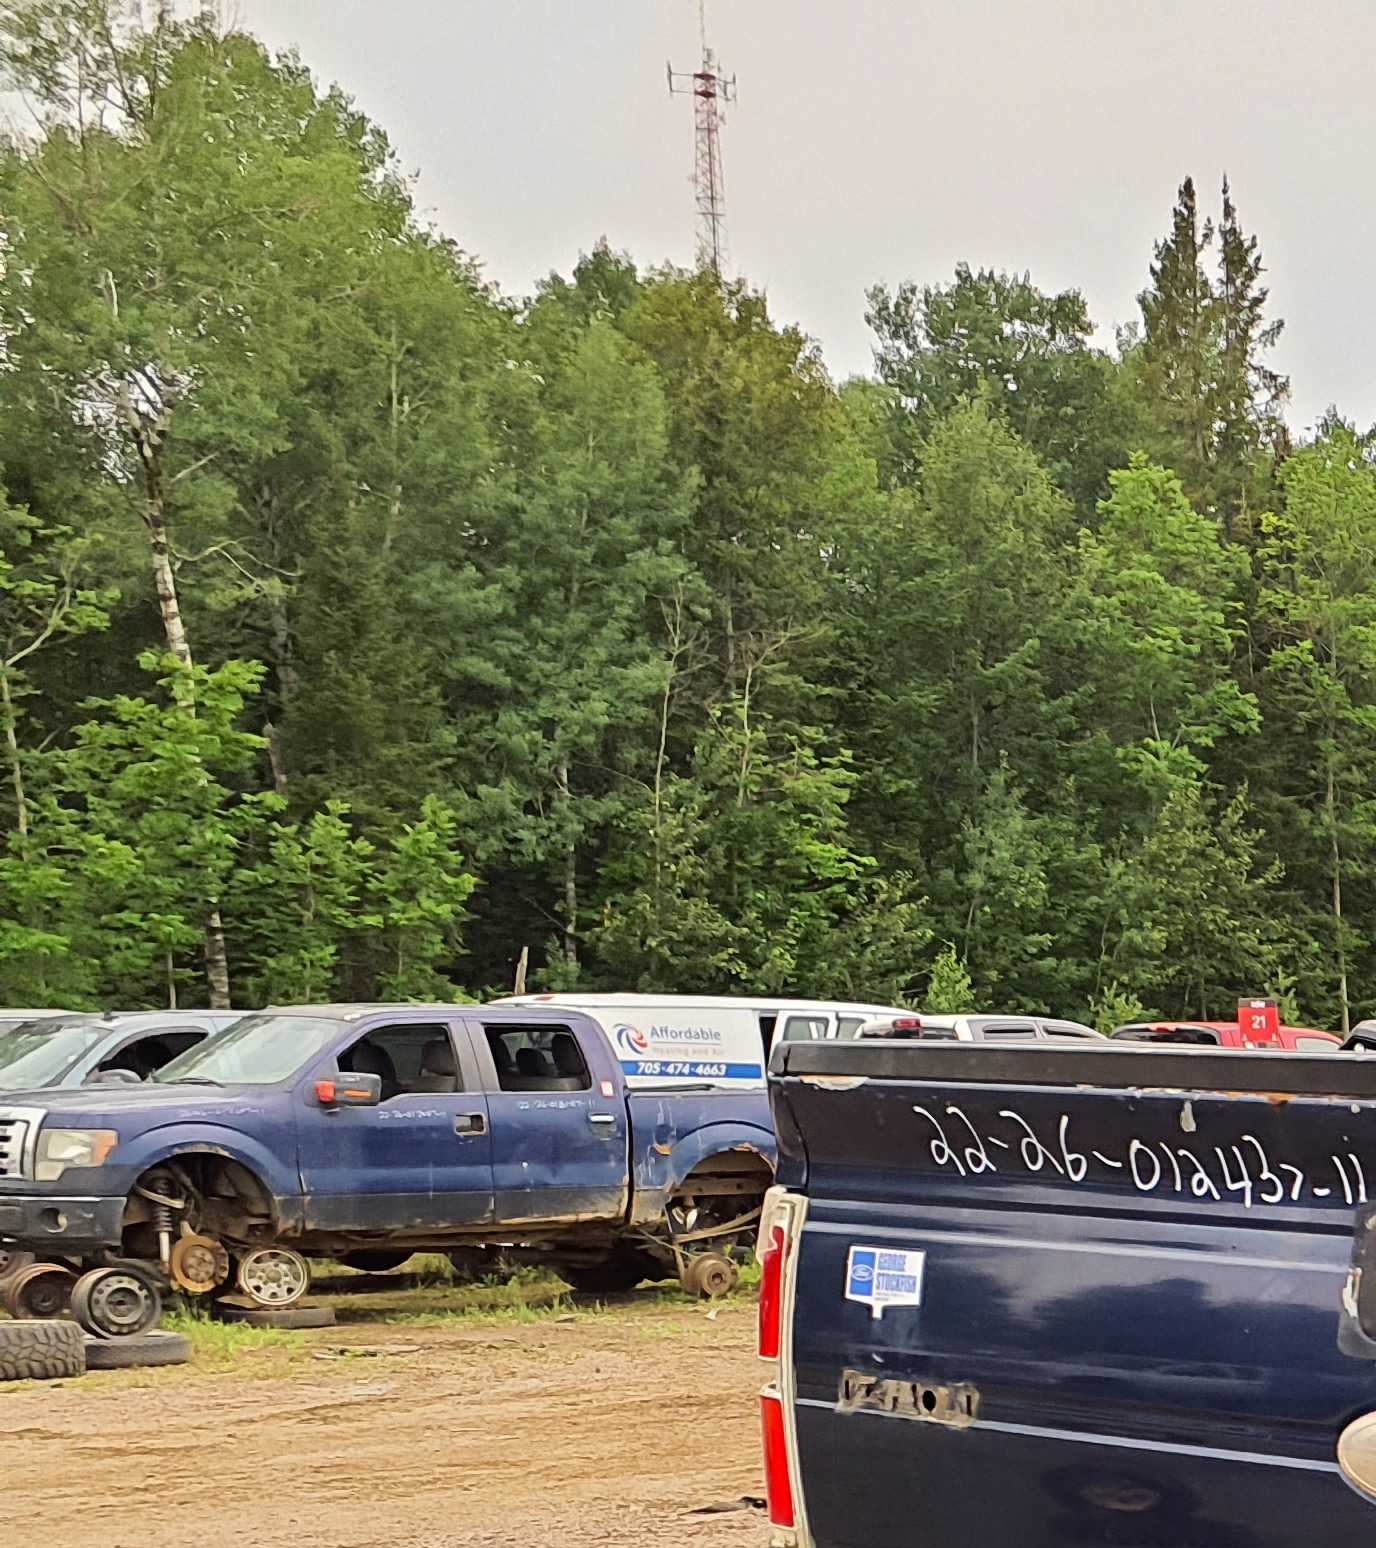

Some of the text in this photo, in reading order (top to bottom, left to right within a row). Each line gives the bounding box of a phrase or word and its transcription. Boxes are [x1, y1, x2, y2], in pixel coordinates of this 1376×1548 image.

[1251, 1015, 1266, 1029] 21
[650, 1025, 721, 1040] Affordable
[913, 1105, 1368, 1207] 22-26-012437-11
